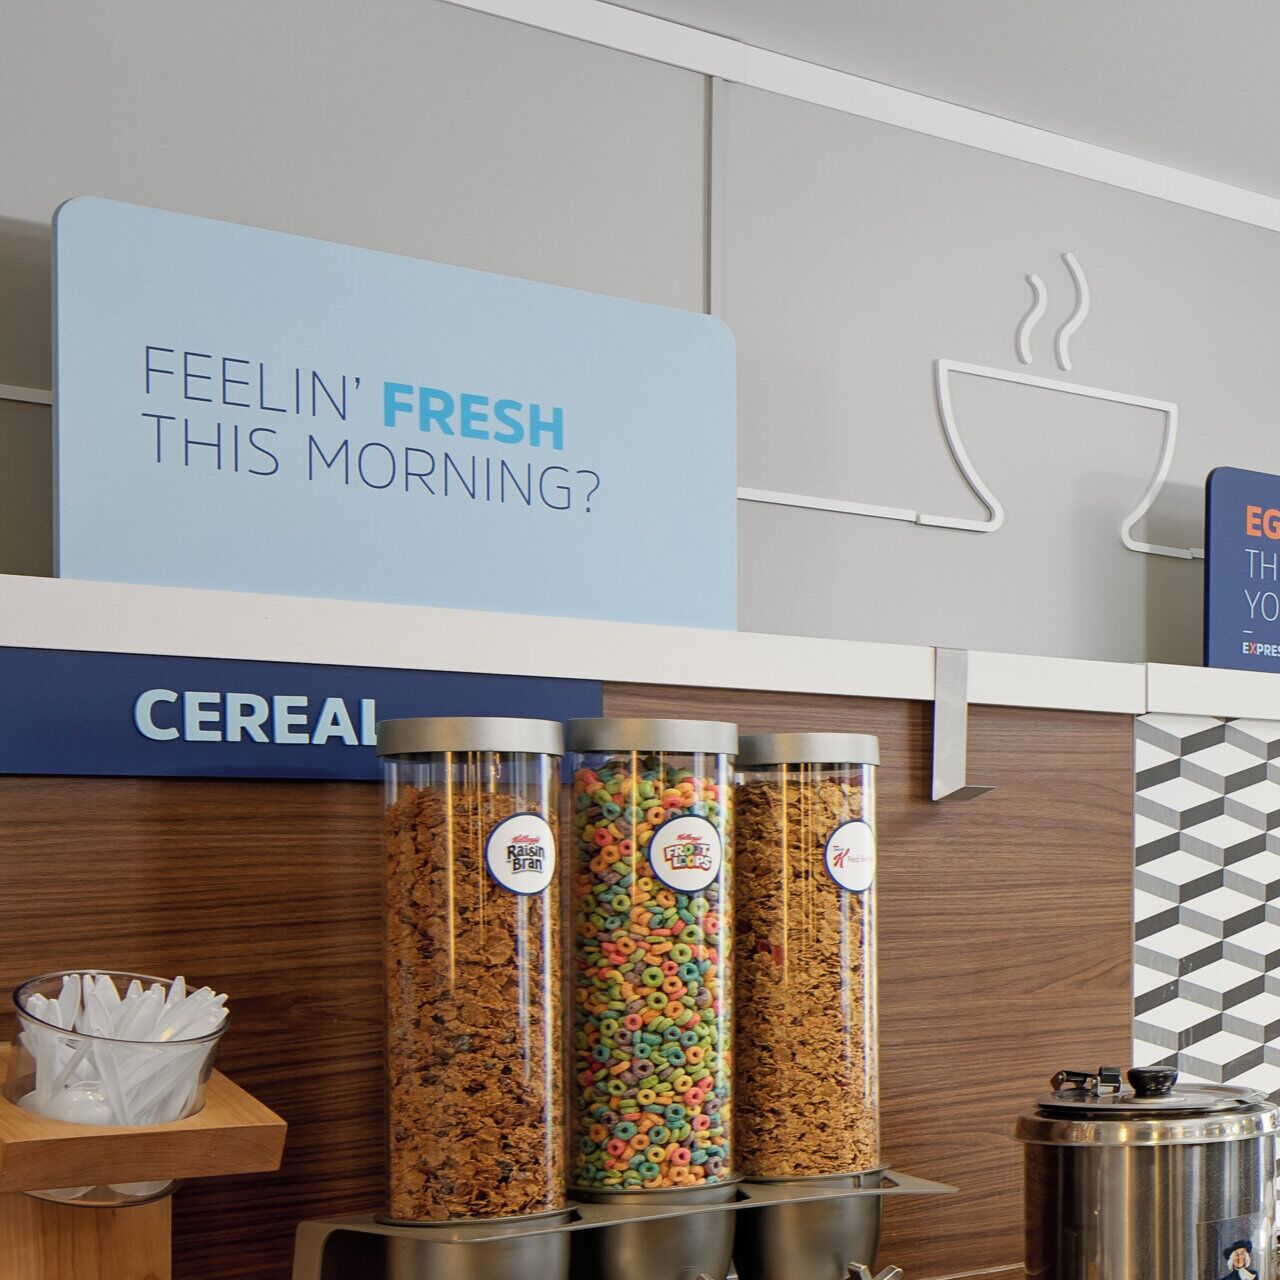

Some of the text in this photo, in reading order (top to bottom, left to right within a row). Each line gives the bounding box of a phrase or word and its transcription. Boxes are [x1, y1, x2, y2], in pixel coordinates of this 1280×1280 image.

[143, 345, 565, 451] FEELIN’ FRESH
[141, 411, 601, 513] THIS MORNING?
[135, 688, 378, 746] CEREAL
[506, 845, 546, 860] Raisin
[512, 858, 543, 871] Bran
[671, 854, 712, 871] LOOPS
